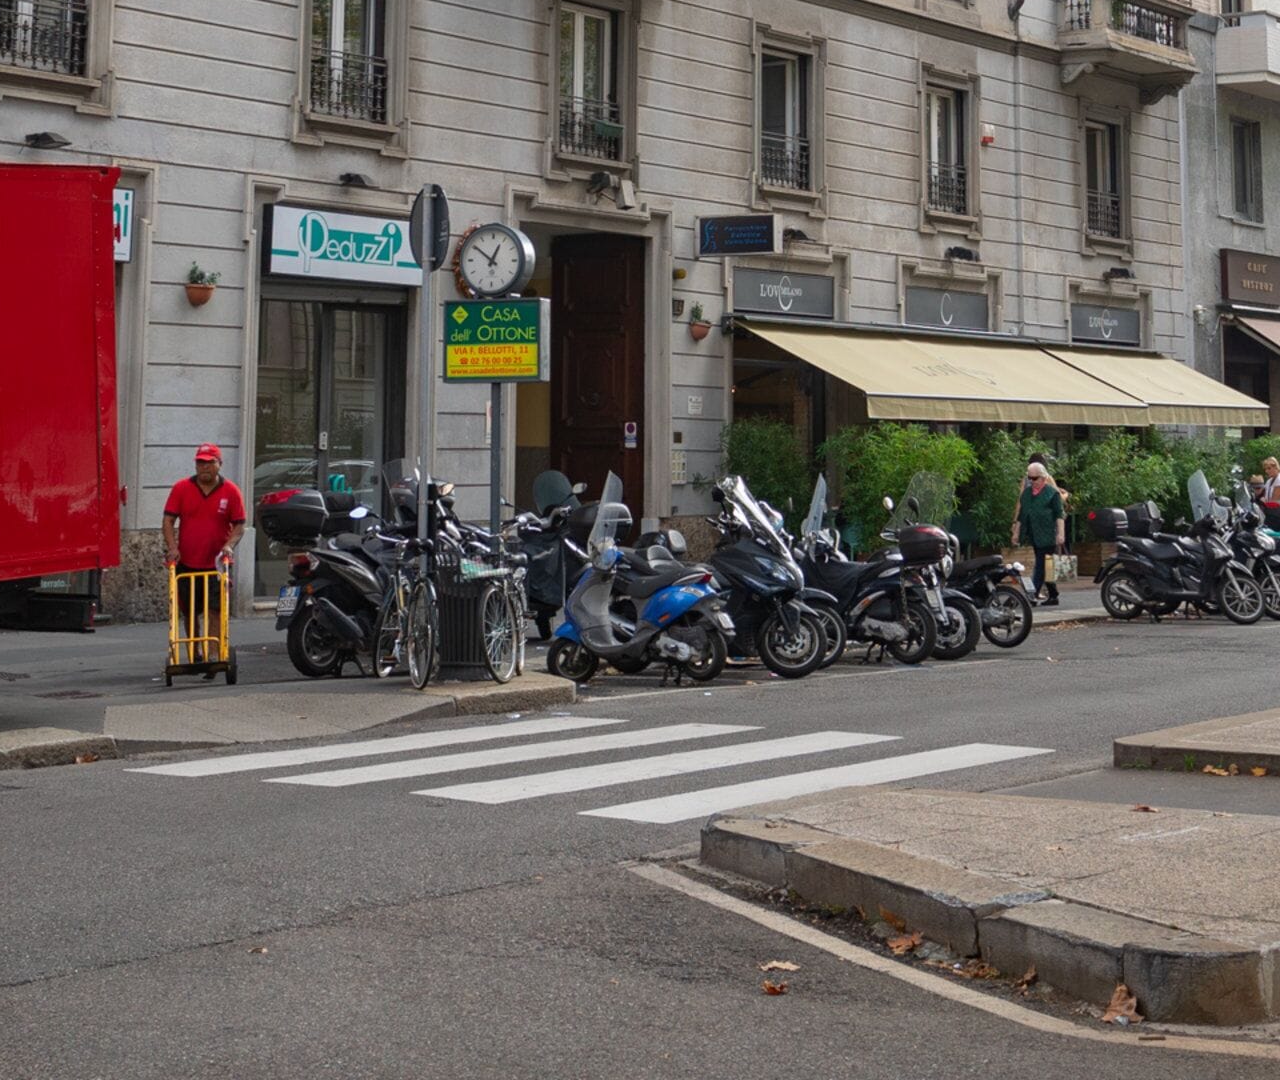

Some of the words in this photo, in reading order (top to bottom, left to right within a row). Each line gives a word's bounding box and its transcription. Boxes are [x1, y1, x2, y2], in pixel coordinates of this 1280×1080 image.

[481, 305, 521, 322] CASA
[450, 328, 472, 342] dell'
[477, 325, 537, 341] OTTONE
[454, 346, 468, 355] VIA
[520, 346, 529, 354] 11
[470, 357, 480, 365] 02
[482, 357, 491, 365] 76
[491, 357, 501, 365] 00
[502, 357, 513, 365] 00
